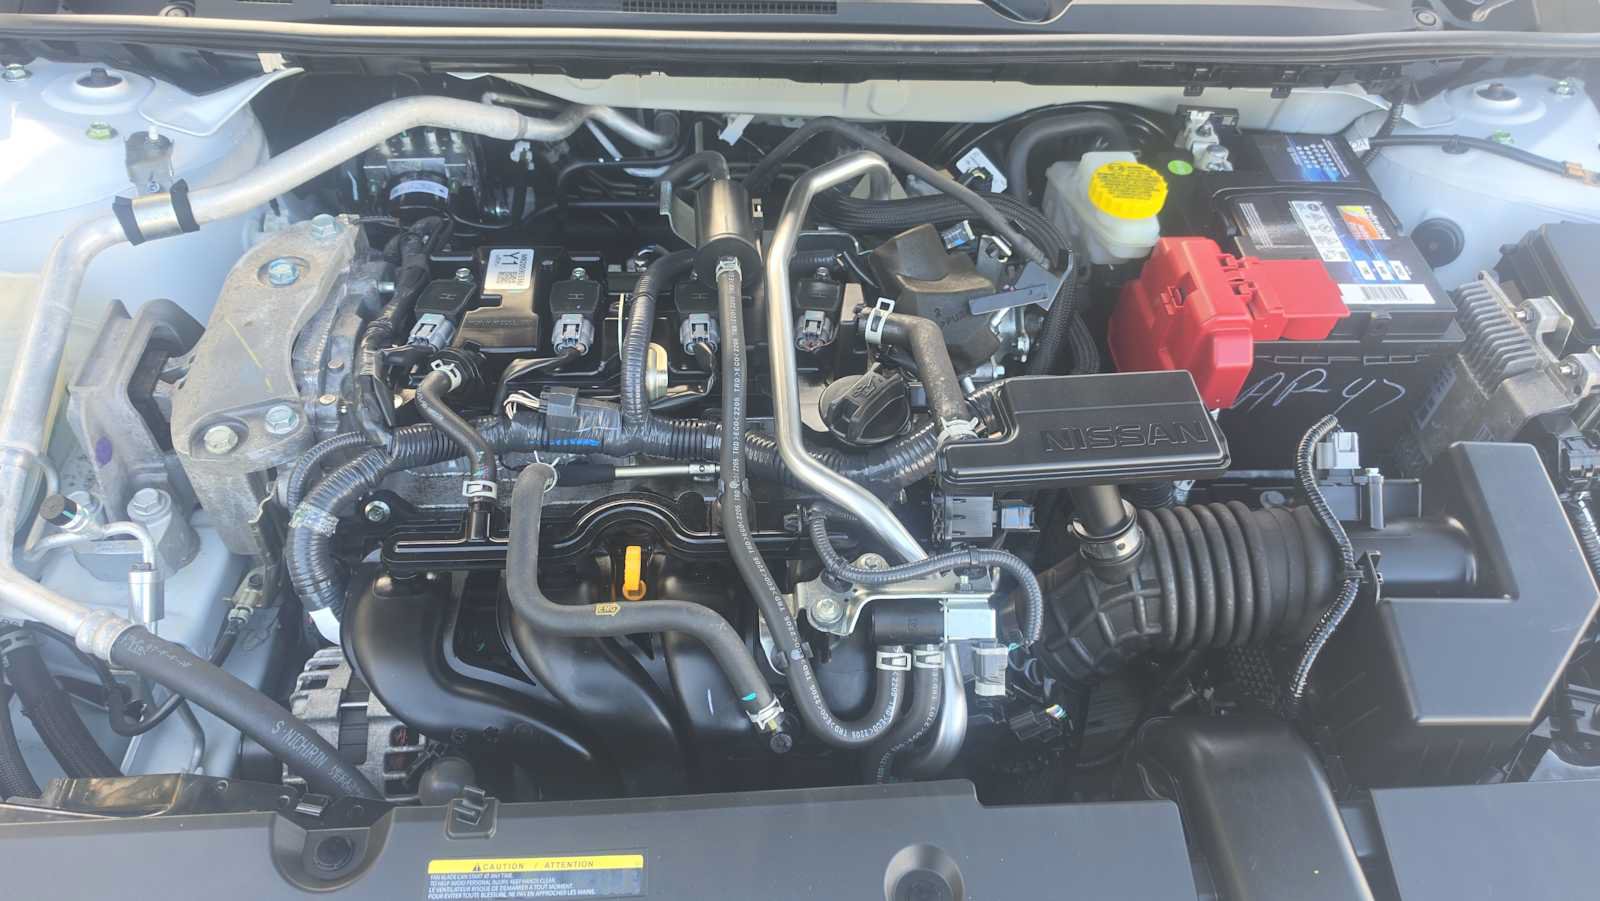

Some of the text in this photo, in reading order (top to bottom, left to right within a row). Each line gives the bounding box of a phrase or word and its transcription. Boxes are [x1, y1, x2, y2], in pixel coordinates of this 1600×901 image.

[501, 252, 520, 264] Y1
[1041, 422, 1208, 451] NISSAN
[544, 860, 593, 868] ATTENTION
